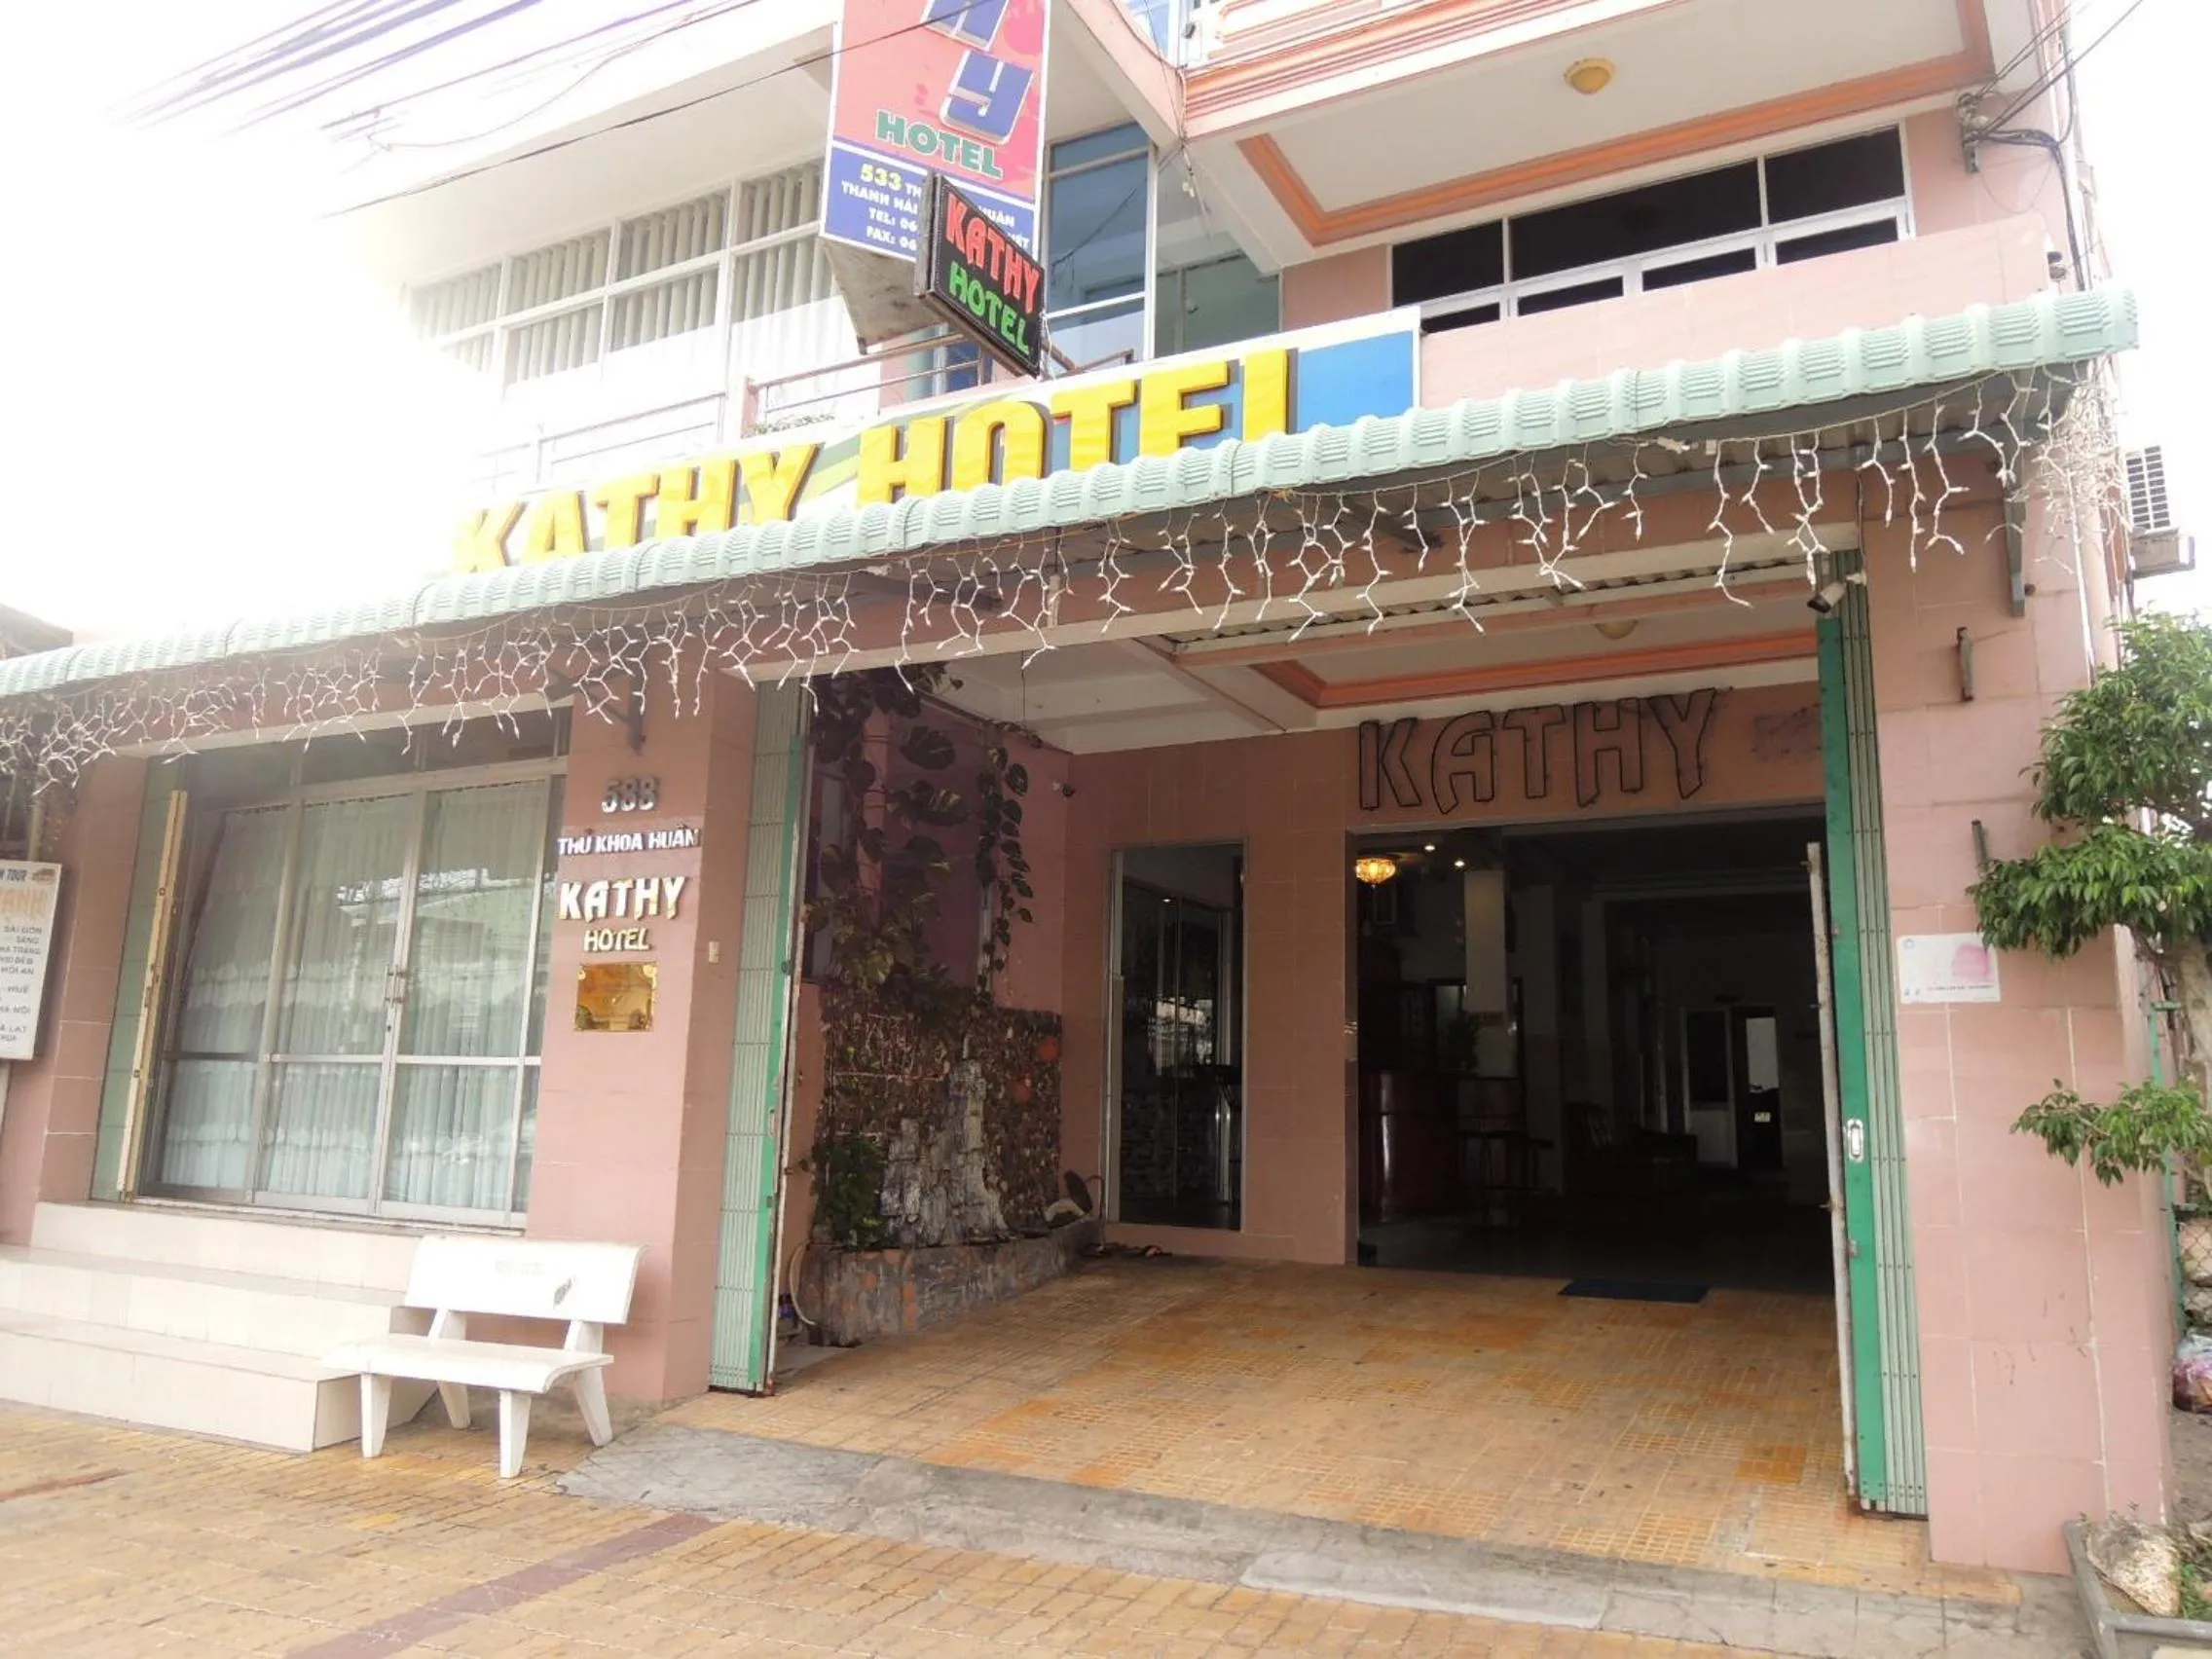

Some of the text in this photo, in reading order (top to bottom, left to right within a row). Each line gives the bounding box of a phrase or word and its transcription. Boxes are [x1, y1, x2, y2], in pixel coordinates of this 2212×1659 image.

[875, 109, 1003, 180] HOTEL
[841, 179, 890, 206] THANH
[860, 163, 903, 191] 533
[904, 182, 922, 199] TH
[899, 236, 918, 251] 06
[900, 217, 918, 233] 06
[944, 192, 1041, 313] KATHY
[949, 260, 1030, 355] HOTEL
[453, 442, 826, 576] KATHY
[1359, 686, 1718, 815] KATHY
[594, 832, 644, 854] KHOA
[559, 876, 686, 923] KATHY
[584, 927, 651, 953] HOTEL
